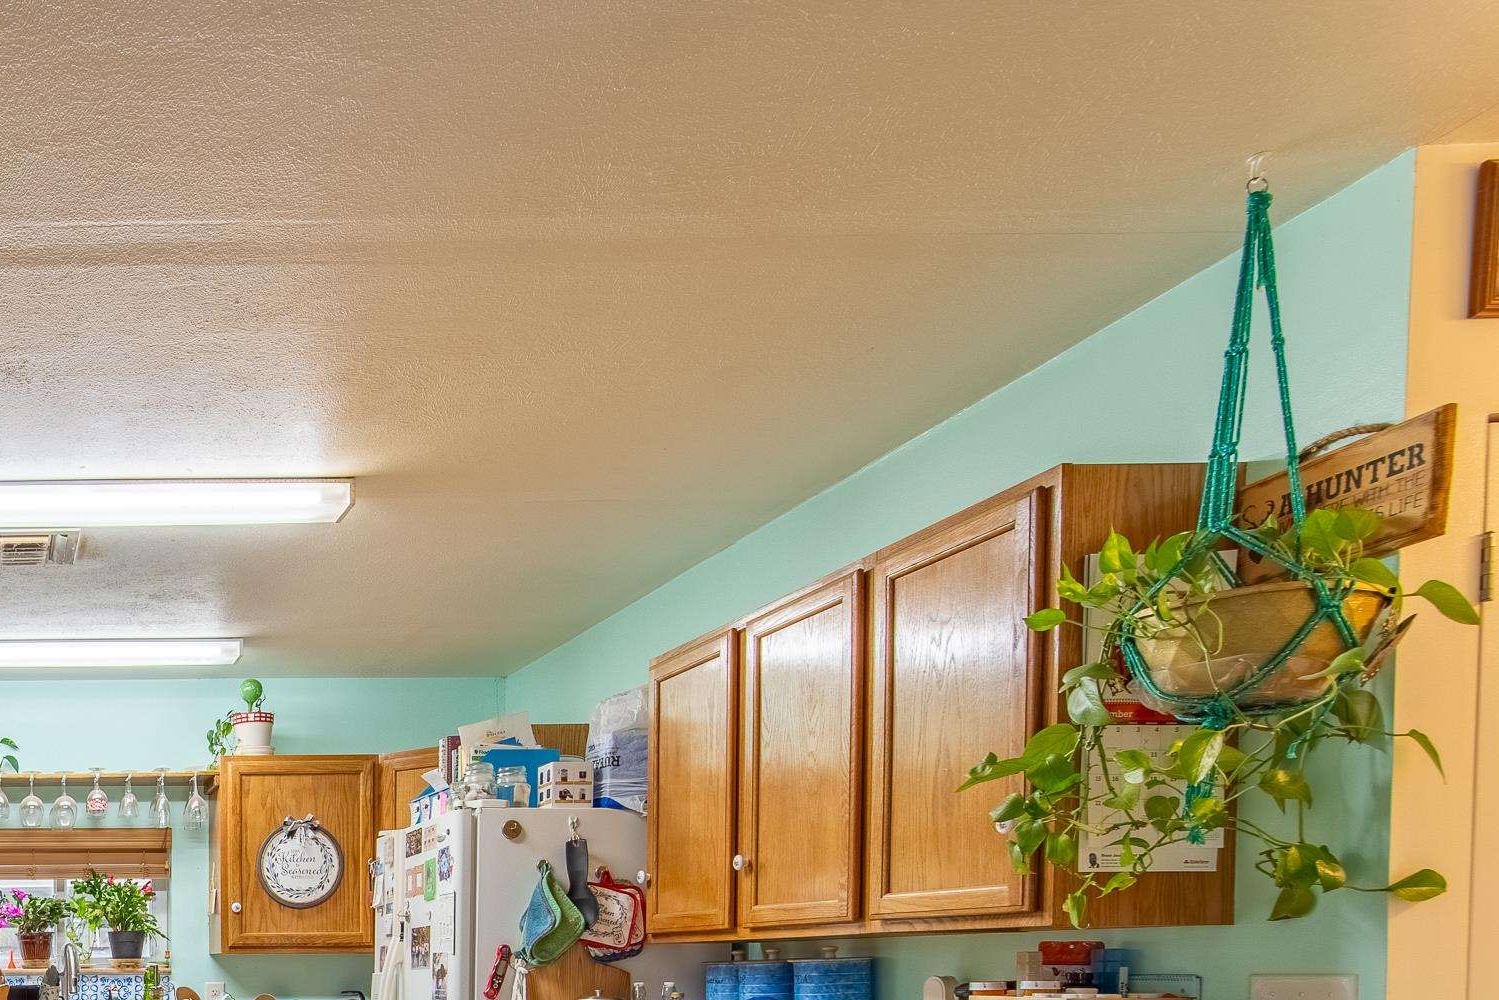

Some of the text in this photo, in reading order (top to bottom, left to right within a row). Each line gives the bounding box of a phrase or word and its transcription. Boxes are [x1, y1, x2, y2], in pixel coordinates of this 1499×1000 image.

[1305, 443, 1426, 509] HUNTER
[1396, 469, 1427, 493] THE
[1388, 491, 1423, 517] LIFE
[277, 851, 316, 863] Kitchen
[281, 864, 323, 876] Seasoned
